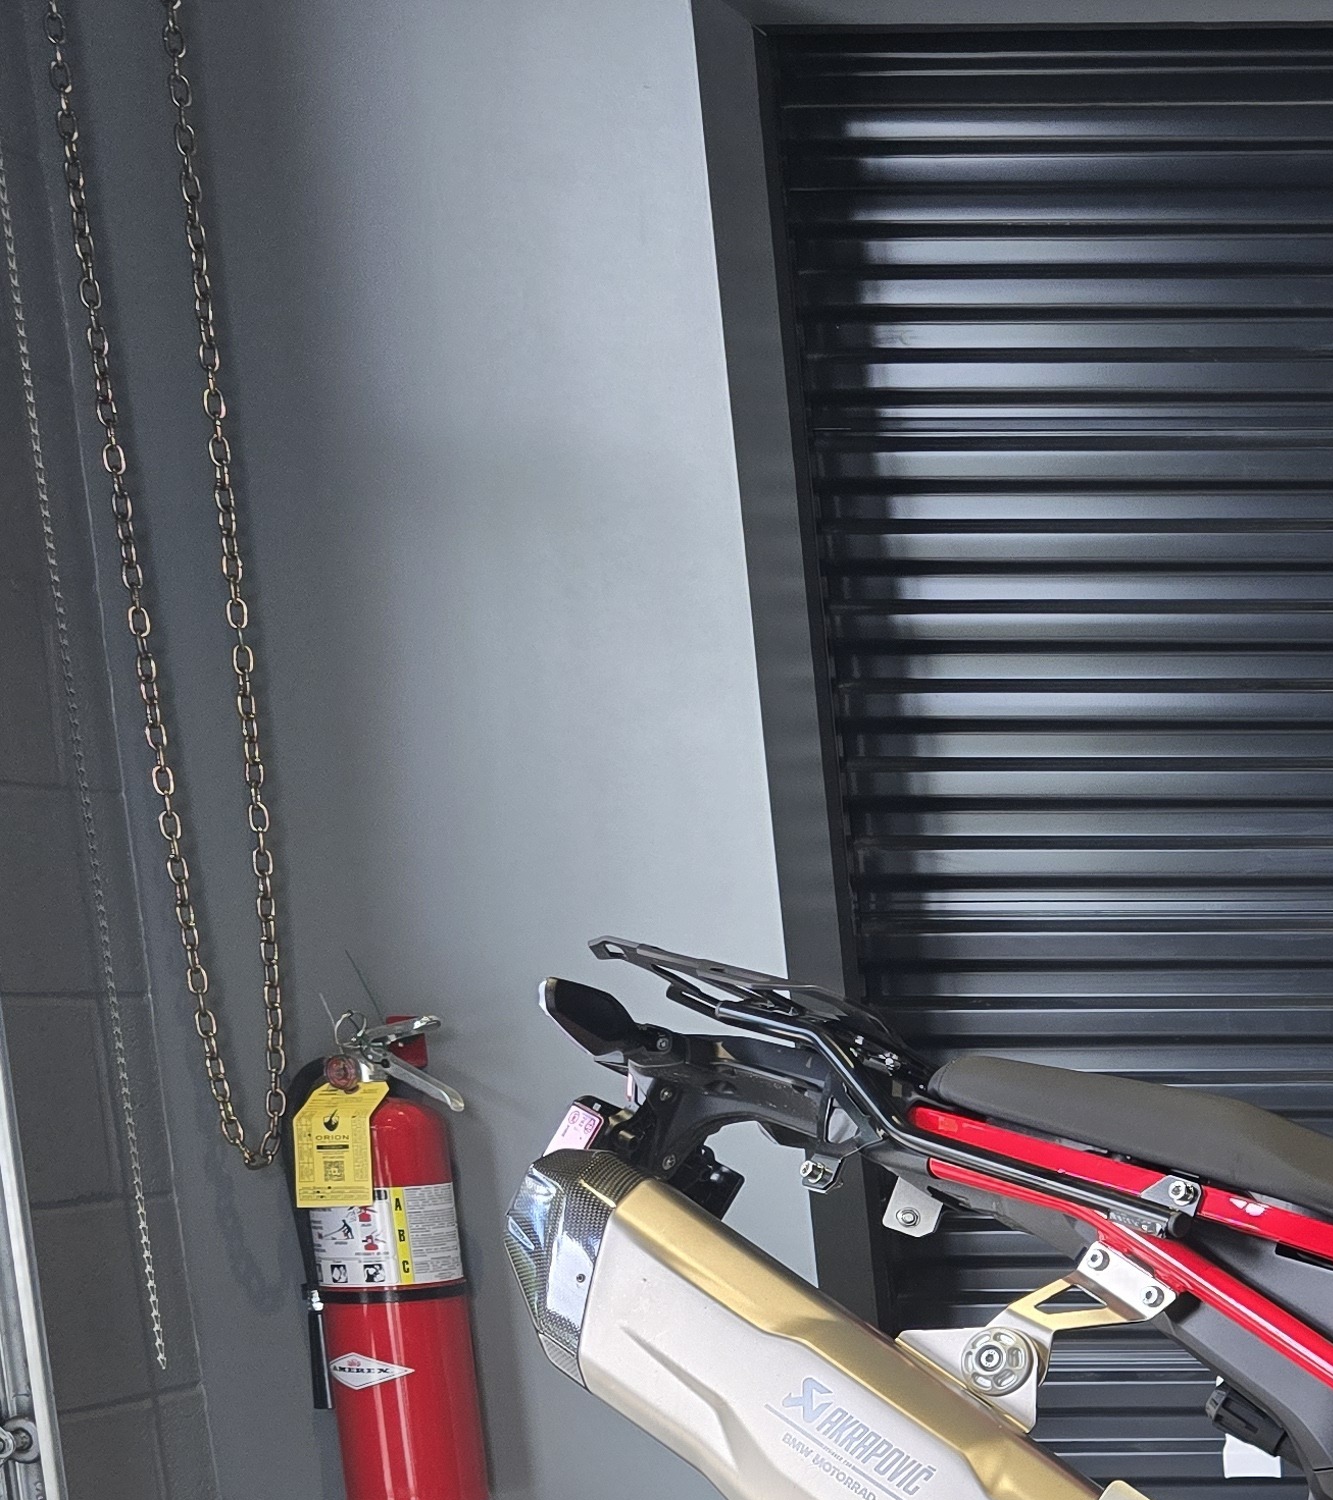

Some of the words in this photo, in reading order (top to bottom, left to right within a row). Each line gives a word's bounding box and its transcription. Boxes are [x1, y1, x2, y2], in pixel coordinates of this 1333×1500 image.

[394, 1198, 403, 1212] A
[397, 1229, 406, 1243] B
[401, 1260, 410, 1274] C
[332, 1365, 390, 1375] AMEREX
[781, 1432, 815, 1459] BMW
